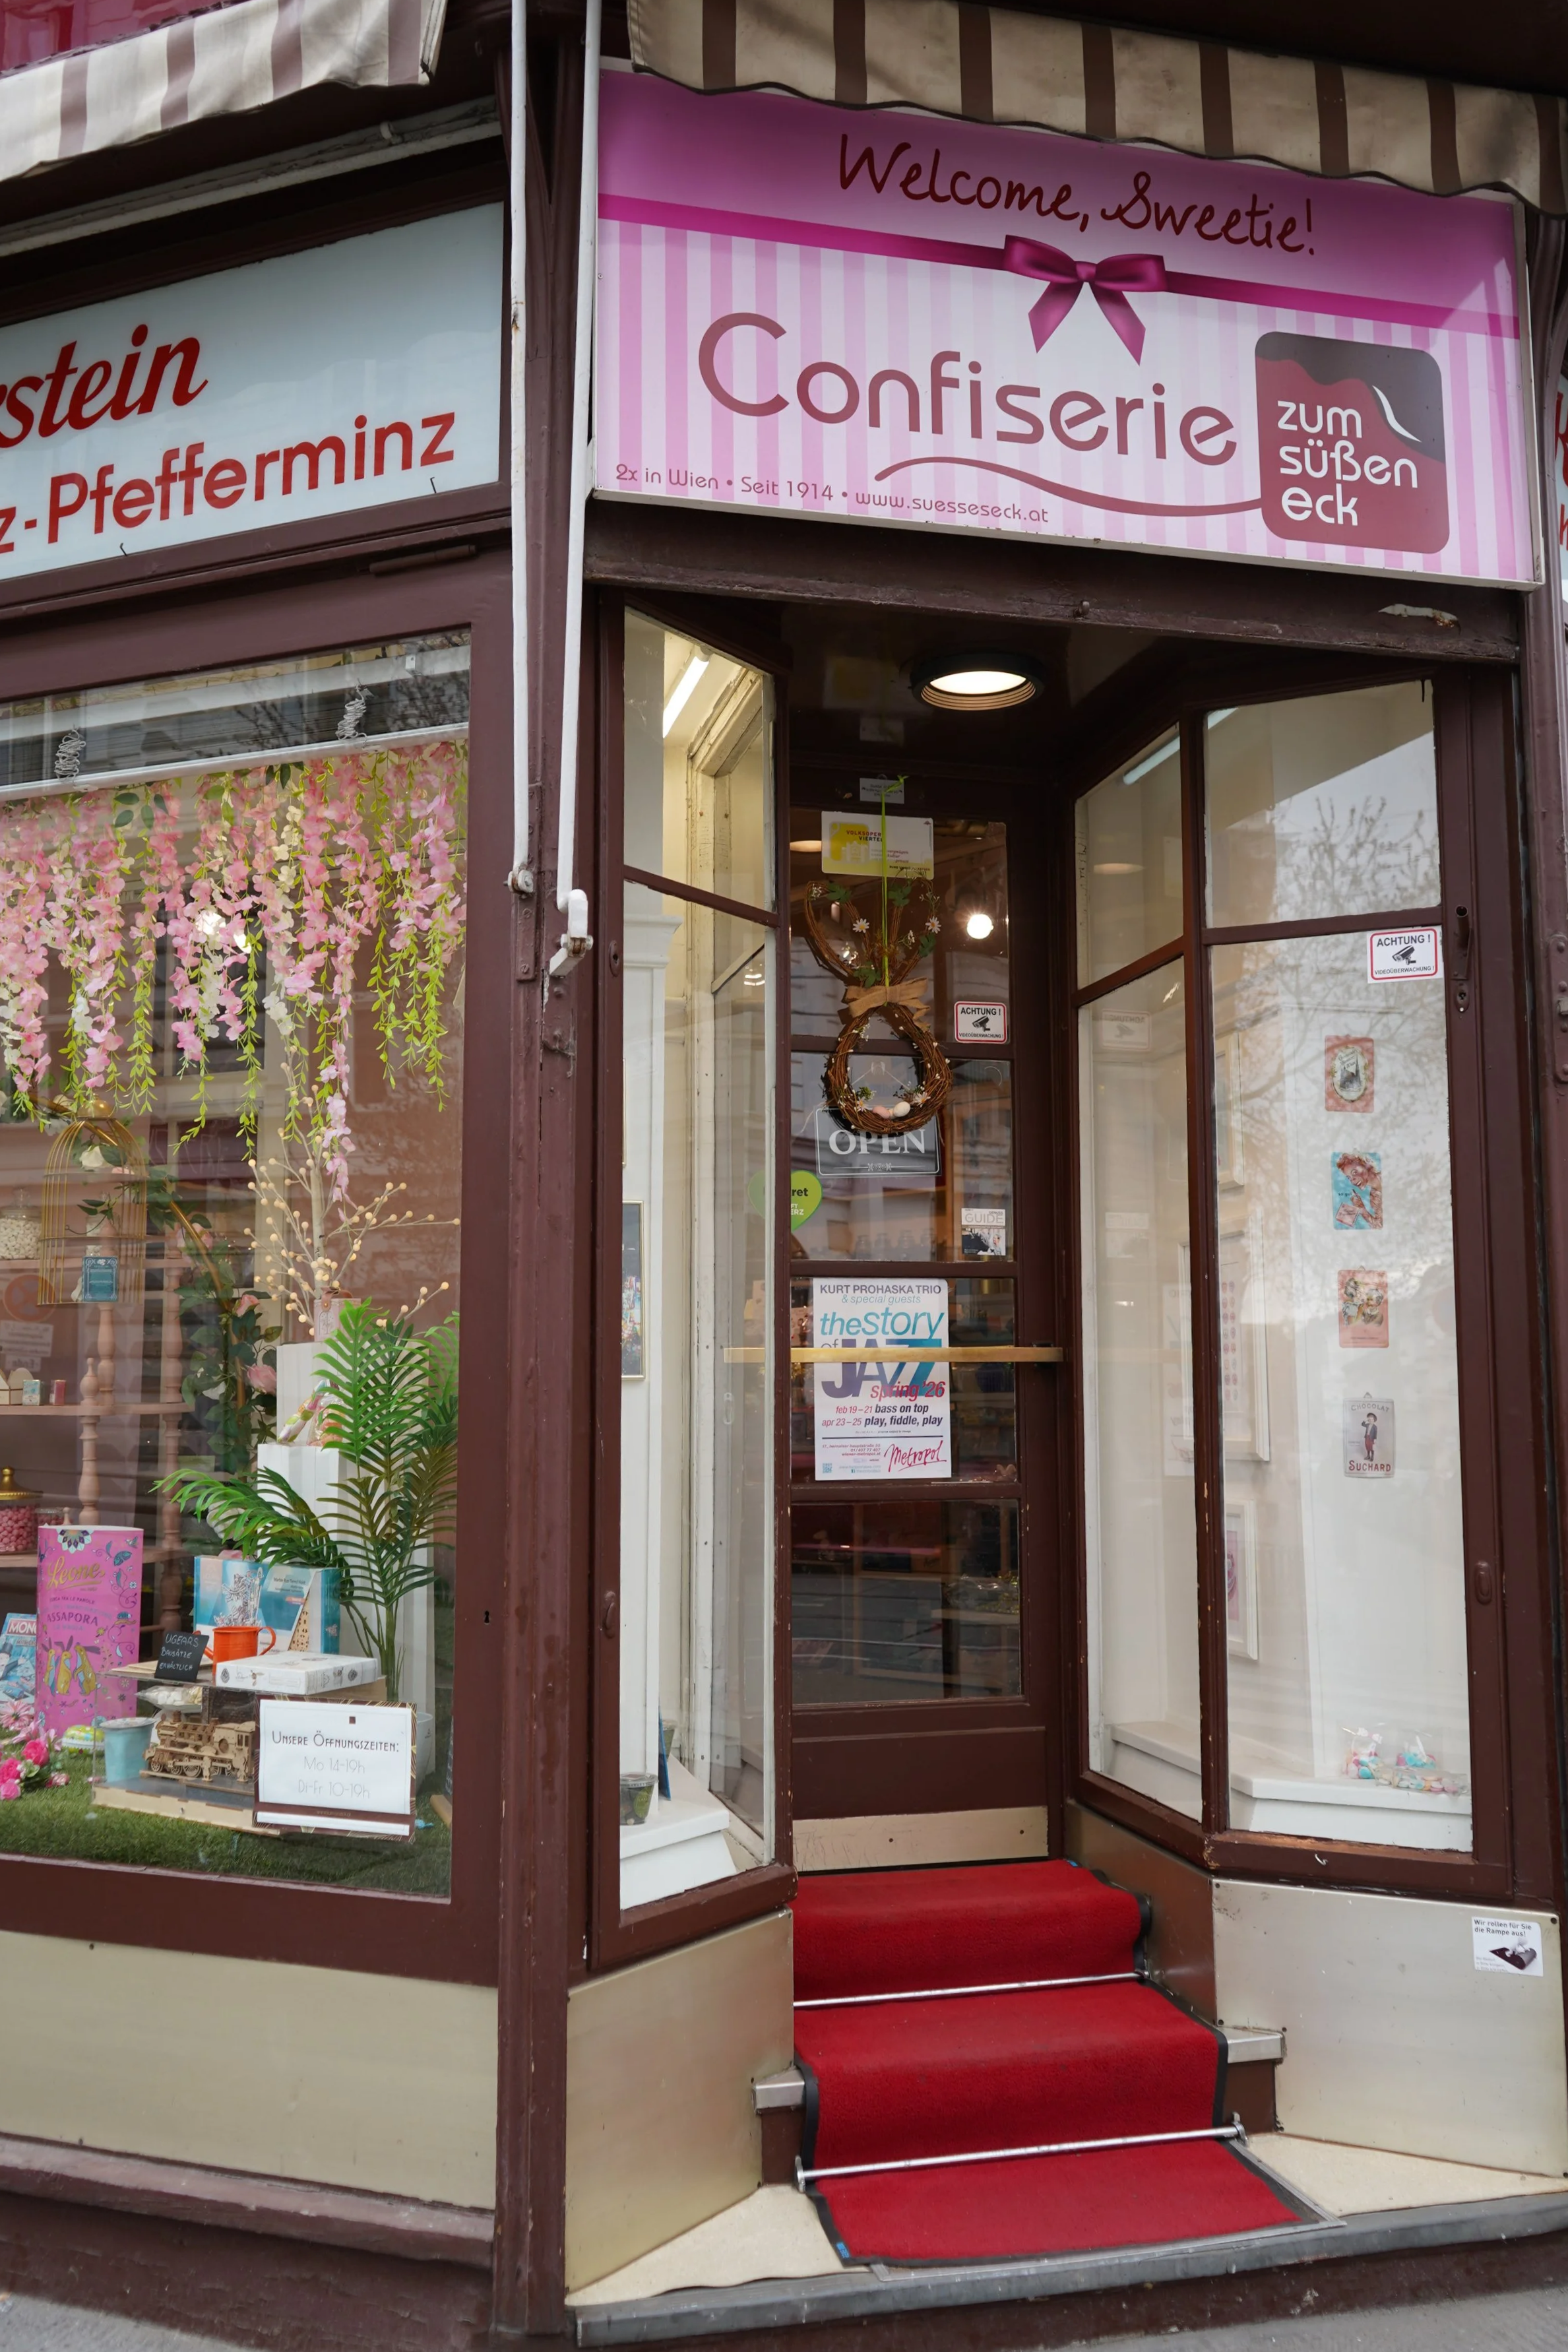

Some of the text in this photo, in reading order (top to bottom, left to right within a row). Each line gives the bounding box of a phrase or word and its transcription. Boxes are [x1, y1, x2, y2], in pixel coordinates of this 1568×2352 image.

[839, 133, 1315, 255] Welcome, Sweetie!
[0, 324, 208, 449] stein
[699, 313, 1237, 466] Confiserie
[1278, 400, 1362, 437] zum
[1280, 440, 1418, 489] süßen
[615, 463, 1049, 523] 2x in Wien Seit 1914 www.suesseseck.at
[1282, 482, 1358, 526] eck
[1377, 935, 1424, 947] ACHTUNG
[1375, 966, 1431, 974] VIDEOÜBERWACHUNG
[829, 1129, 925, 1155] OPEN
[965, 1213, 1004, 1224] GUIDE
[820, 1285, 941, 1294] KURT PROHASKA TRIO
[849, 1294, 886, 1304] special
[889, 1295, 921, 1306] guests
[870, 1381, 920, 1402] spring
[836, 1405, 847, 1414] feb
[875, 1404, 897, 1413] bass
[914, 1404, 929, 1415] top
[1350, 1403, 1390, 1413] CHOCOLAT
[822, 1419, 834, 1428] apr
[865, 1416, 887, 1428] play,
[890, 1416, 920, 1427] fiddle,
[922, 1416, 943, 1427] play
[1348, 1459, 1392, 1473] SUCHARD
[46, 1556, 105, 1590] Leone
[47, 1612, 98, 1626] ASSAPORA
[165, 1633, 199, 1648] UGEARS
[303, 1756, 365, 1773] Mo 14-19h
[298, 1779, 370, 1799] Di-Fr 10-19h
